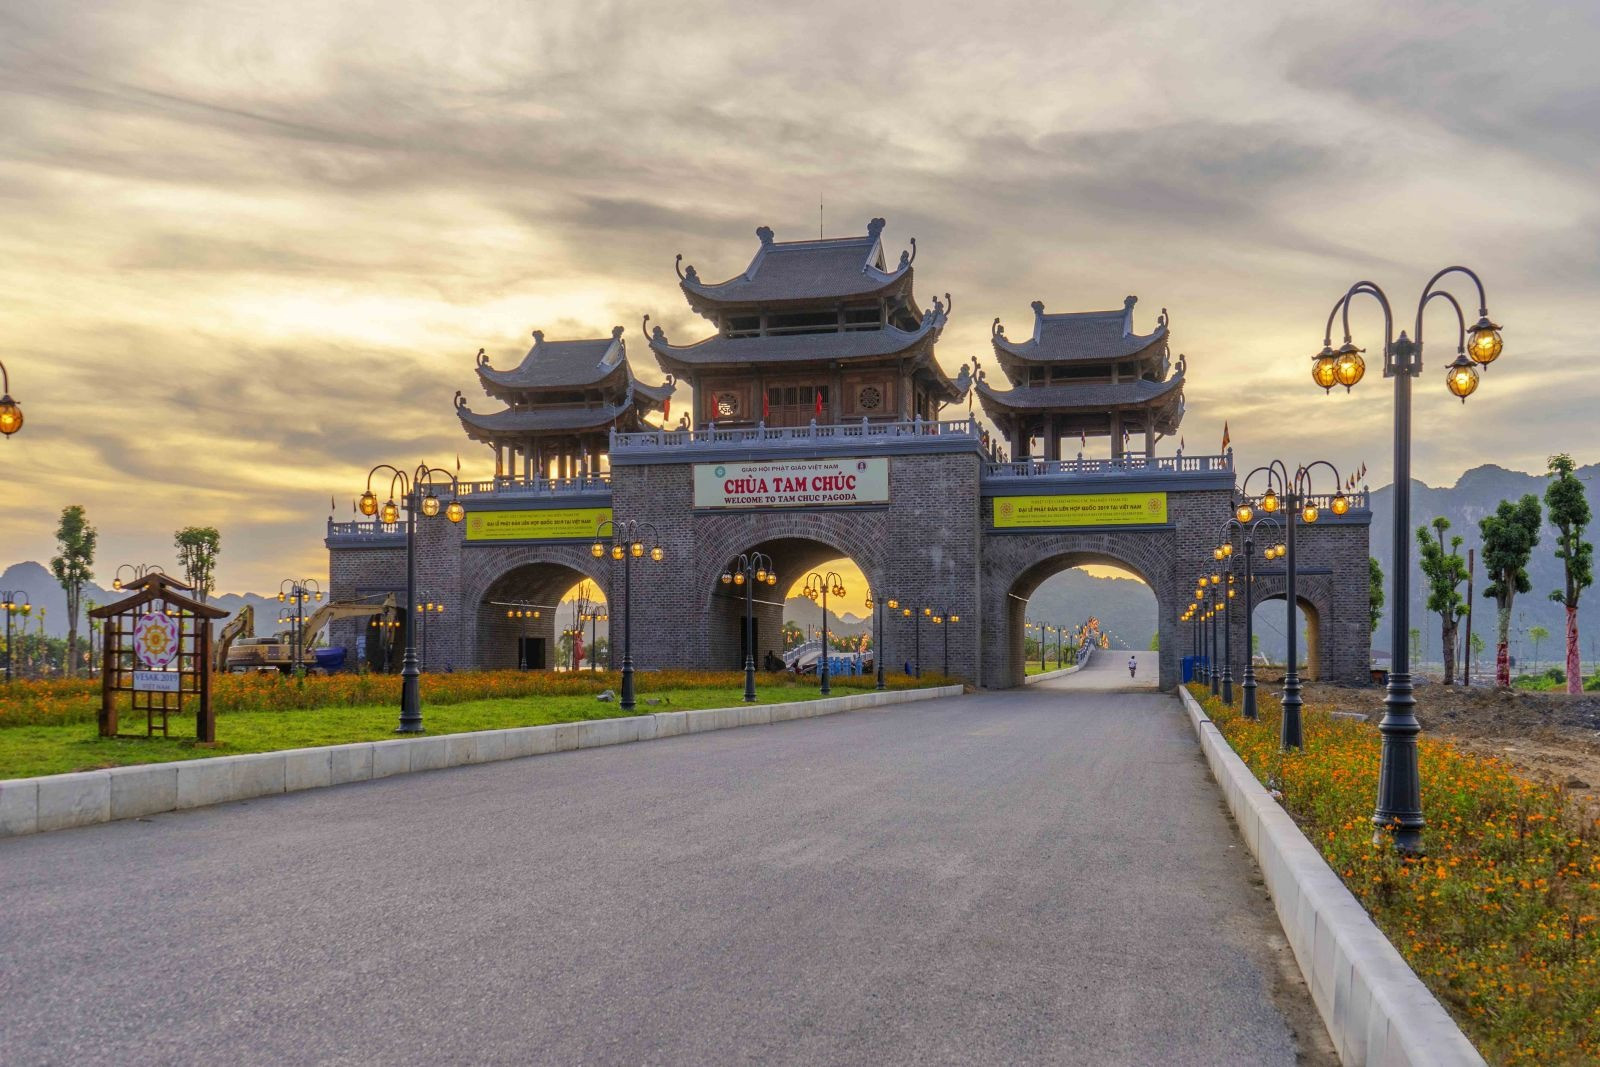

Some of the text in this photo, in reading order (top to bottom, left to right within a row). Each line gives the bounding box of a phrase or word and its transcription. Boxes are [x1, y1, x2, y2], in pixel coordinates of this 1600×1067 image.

[724, 471, 857, 494] CHÙA TAM CHÚC
[724, 496, 763, 505] WELCOME
[777, 495, 796, 503] TAM
[798, 494, 820, 502] CHUC
[822, 493, 857, 502] PAGODA
[135, 673, 178, 682] VESAK 2019
